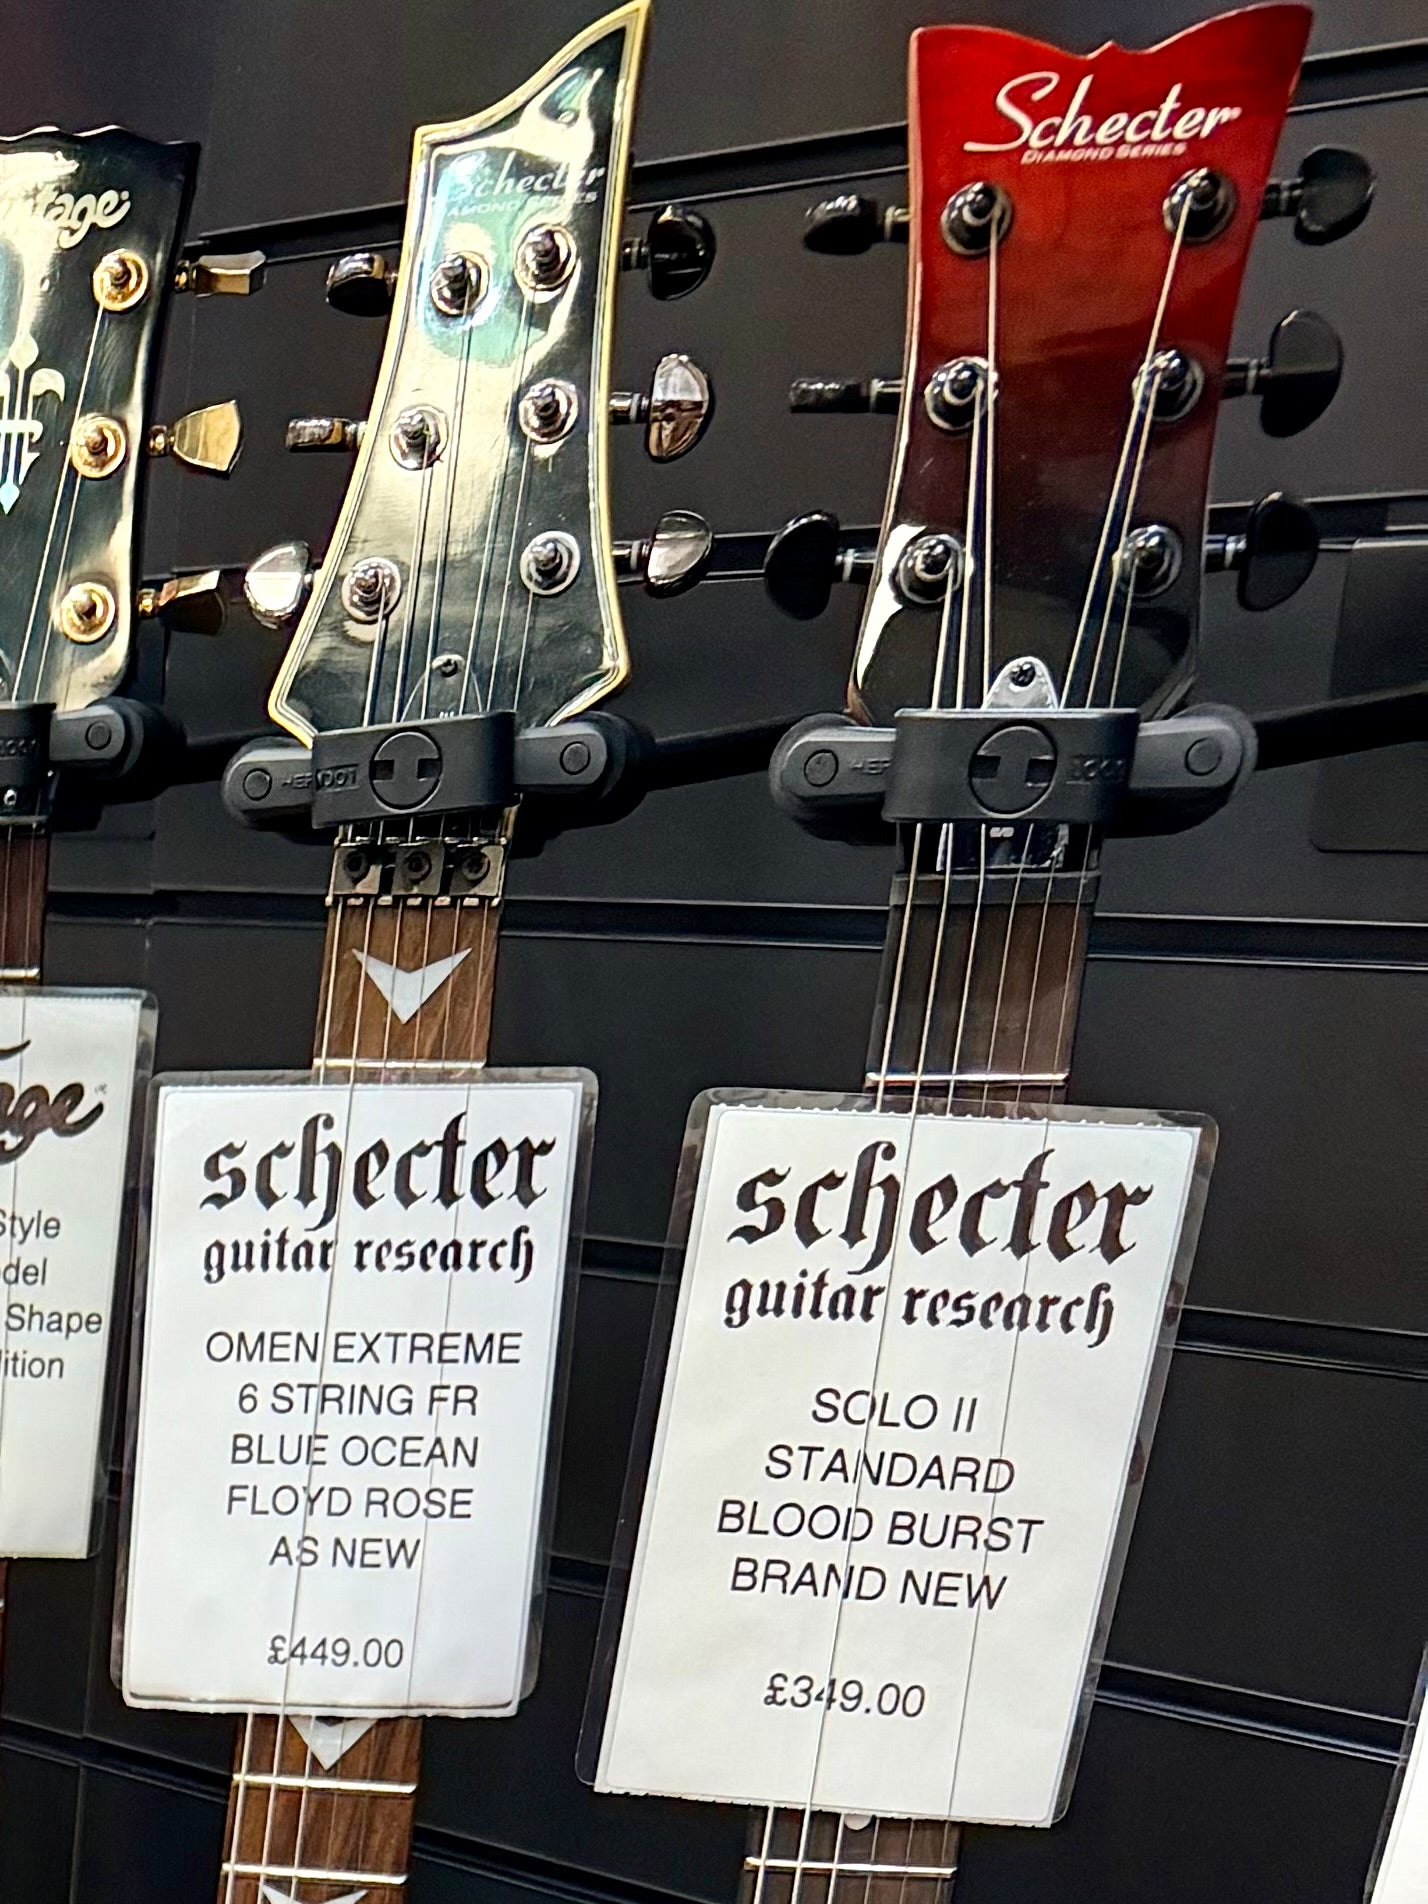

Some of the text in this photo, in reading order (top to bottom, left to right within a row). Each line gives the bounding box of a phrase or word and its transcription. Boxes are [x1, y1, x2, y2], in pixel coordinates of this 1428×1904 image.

[964, 71, 1242, 152] Schecter
[1021, 141, 1187, 165] DIAMOND SERIES
[199, 1110, 558, 1232] schecter
[726, 1139, 1154, 1276] schecter
[203, 1225, 536, 1284] guitar research
[5, 1303, 103, 1341] Shape
[724, 1270, 1116, 1349] guitar research
[206, 1331, 523, 1365] OMEN EXTREME
[238, 1383, 478, 1417] 6 STRING FR
[811, 1386, 979, 1434] SOLO II
[230, 1434, 479, 1468] BLUE OCEAN
[764, 1444, 1016, 1495] STANDARD
[226, 1484, 473, 1520] FLOYD ROSE
[716, 1499, 1045, 1556] BLOOD BURST
[269, 1535, 422, 1570] AS NEW
[729, 1556, 1008, 1612] BRAND NEW
[268, 1635, 405, 1668] £449.00
[763, 1671, 927, 1718] £349.00
